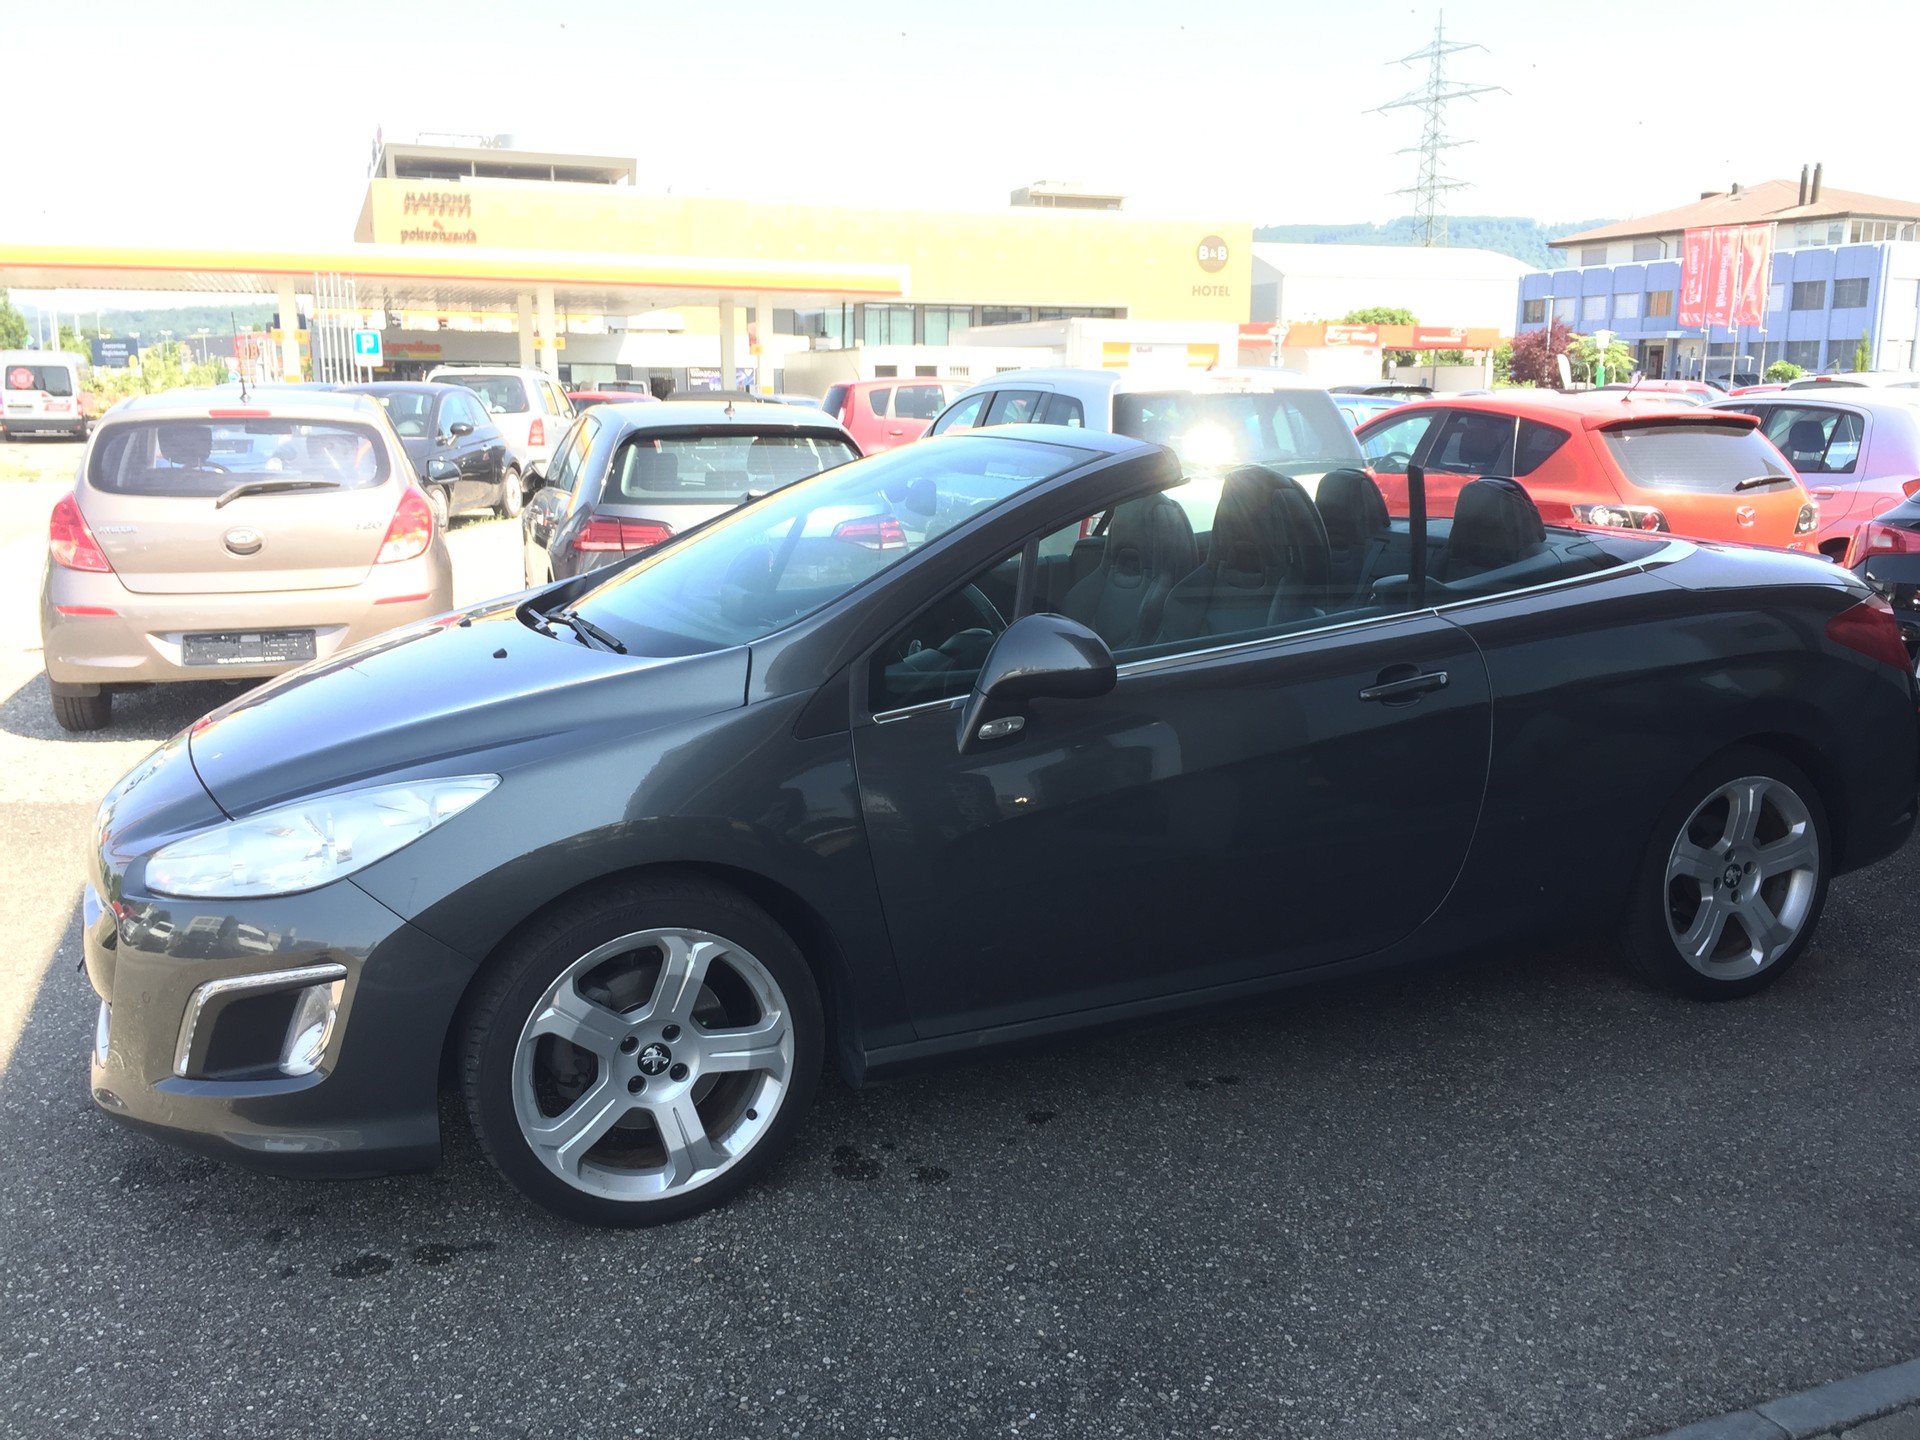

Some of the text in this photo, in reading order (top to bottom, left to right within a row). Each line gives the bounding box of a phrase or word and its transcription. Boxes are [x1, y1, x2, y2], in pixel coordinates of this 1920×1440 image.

[1199, 245, 1228, 261] B&B
[1192, 285, 1231, 297] HOTEL
[361, 335, 375, 353] P
